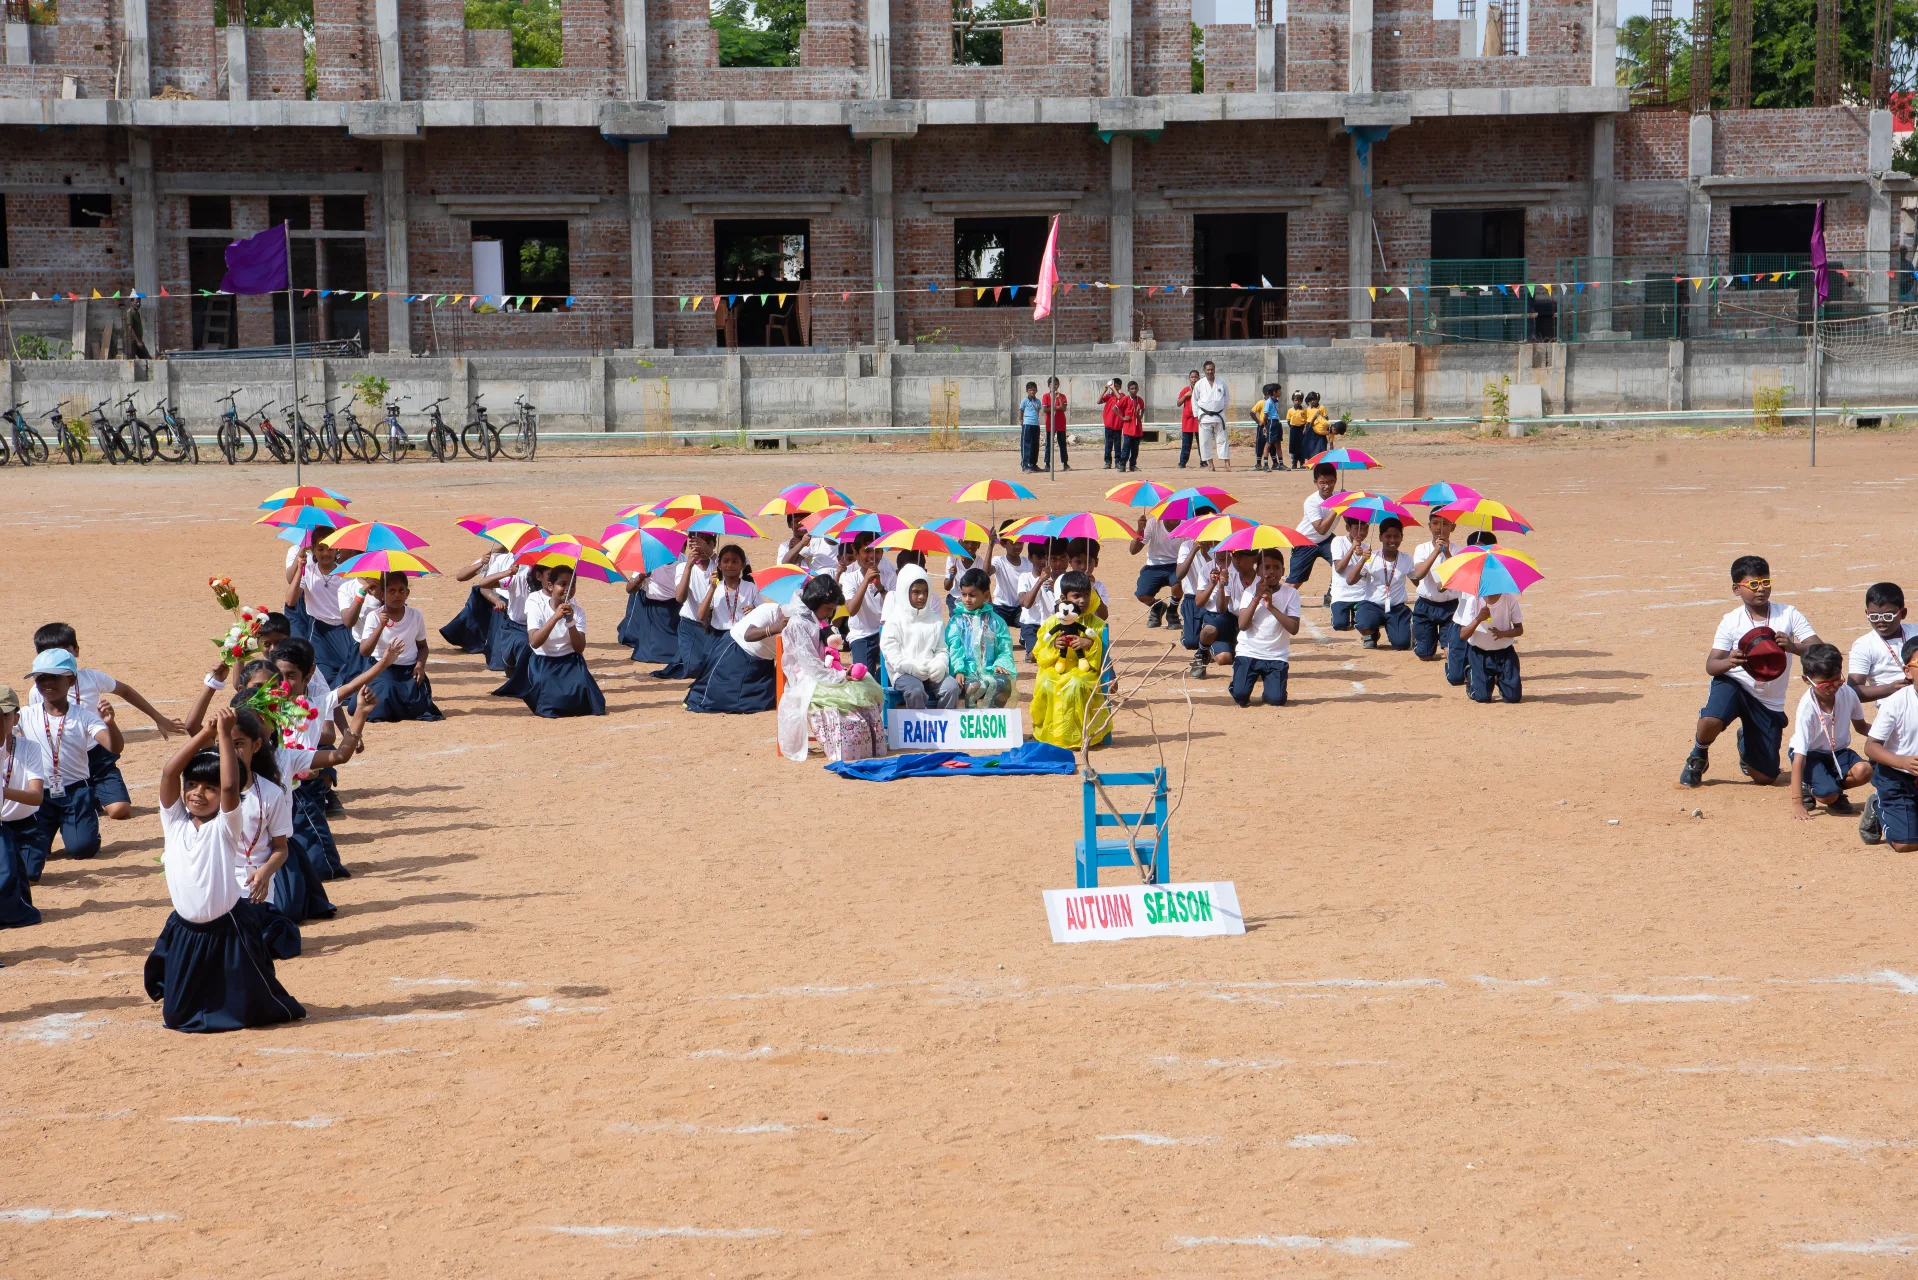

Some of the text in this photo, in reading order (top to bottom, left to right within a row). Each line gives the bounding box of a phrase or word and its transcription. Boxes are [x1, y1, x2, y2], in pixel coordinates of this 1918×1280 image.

[903, 714, 1007, 743] RAINY SEASON
[1065, 890, 1214, 931] AUTUMN SEASON
